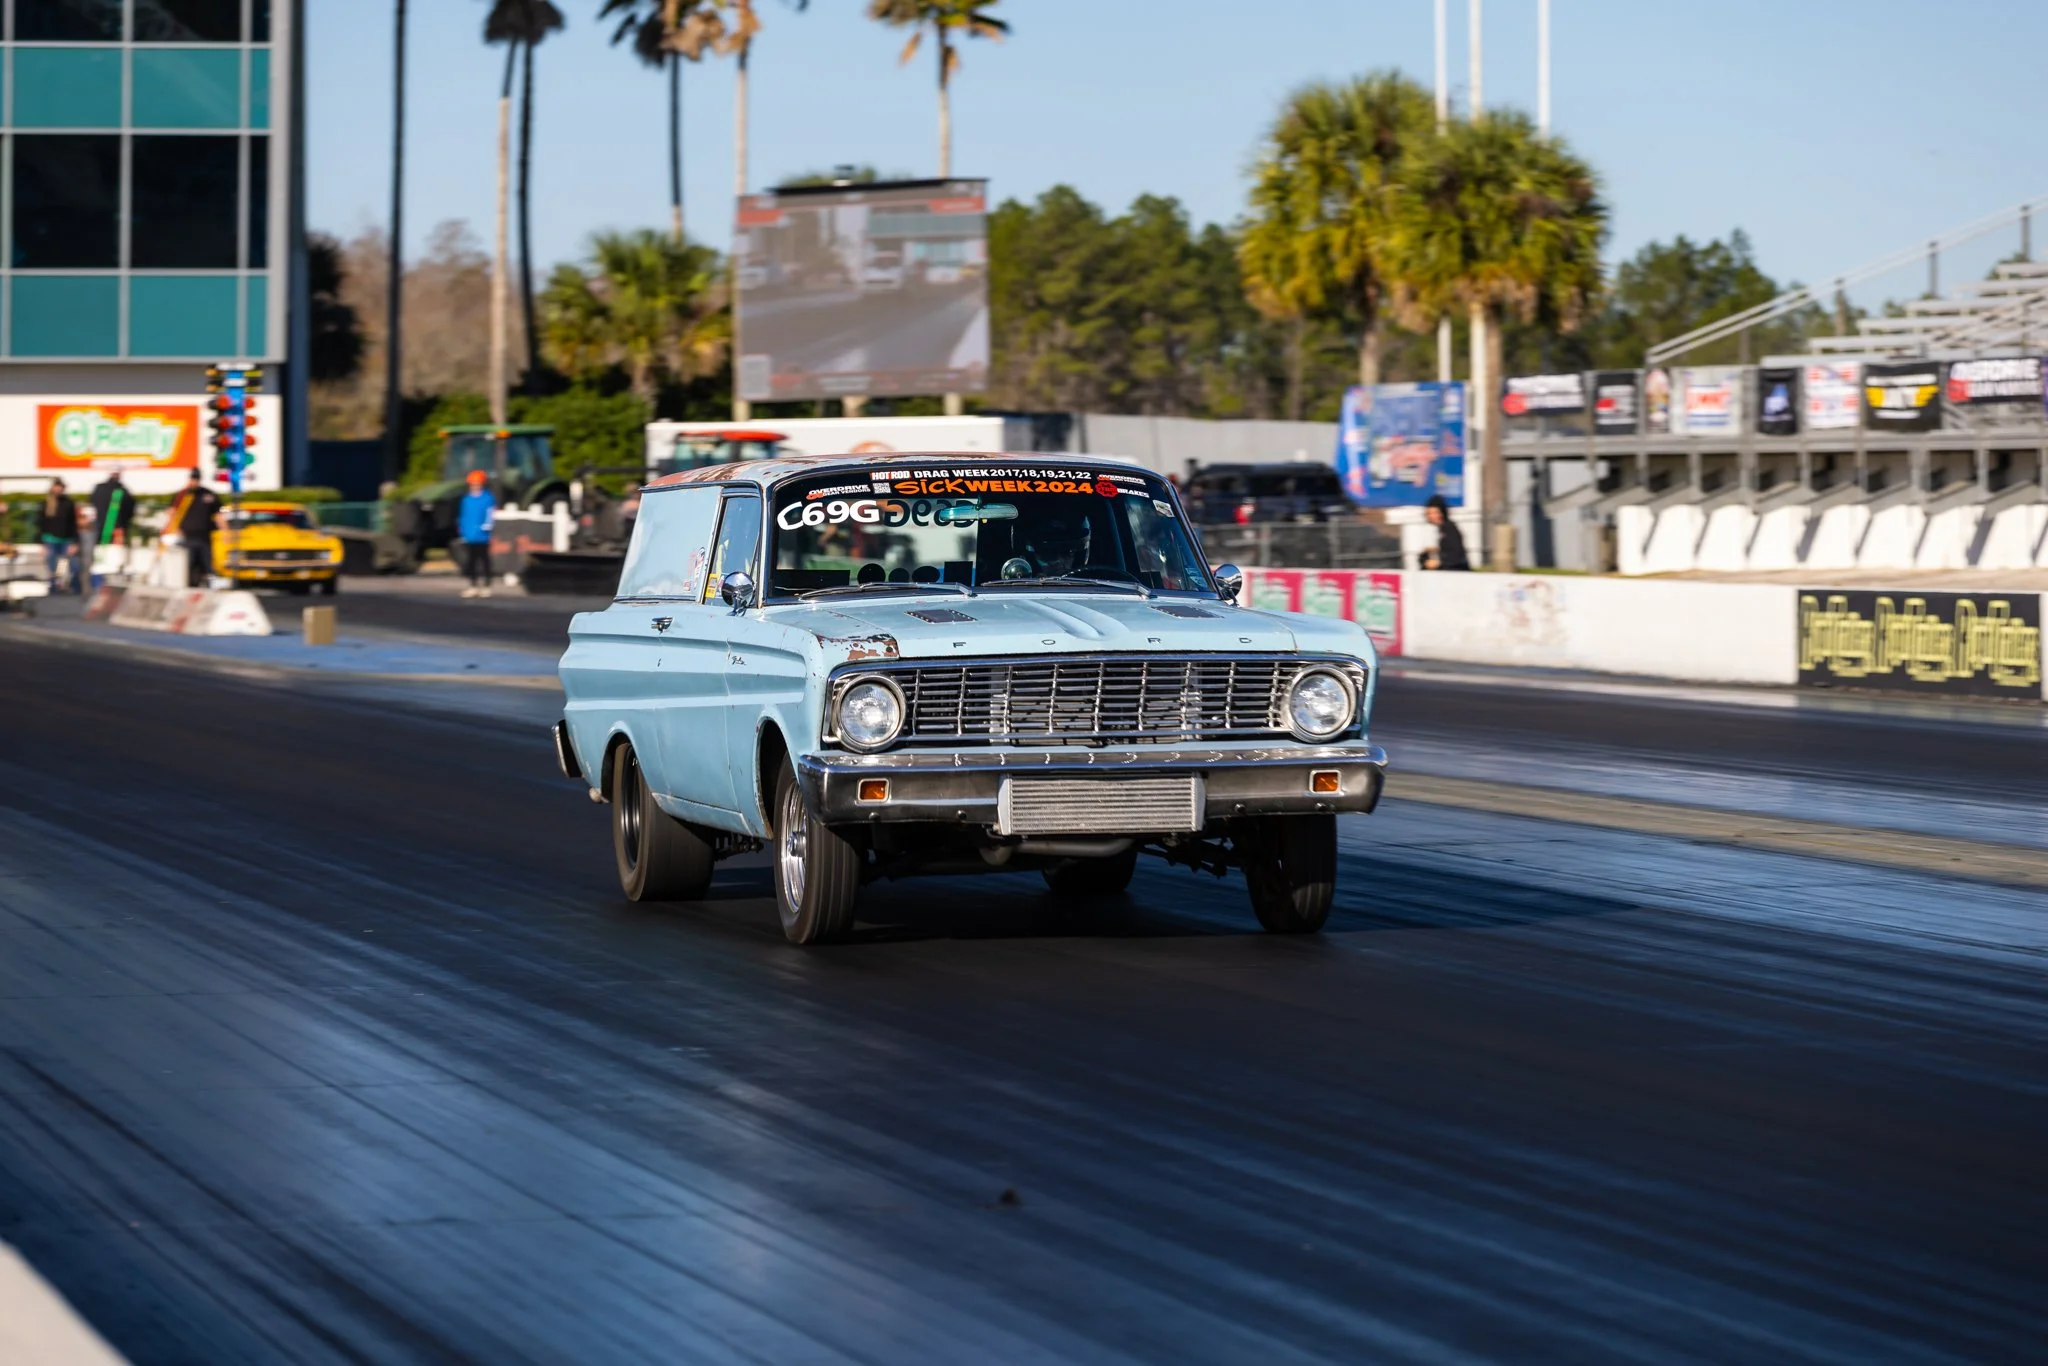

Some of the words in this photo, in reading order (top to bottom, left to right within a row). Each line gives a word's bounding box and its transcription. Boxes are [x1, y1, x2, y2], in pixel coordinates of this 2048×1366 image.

[871, 472, 890, 480] HOT
[891, 471, 910, 479] ROD
[914, 470, 949, 478] DRAG
[808, 484, 869, 495] OVERDRIVE
[1117, 488, 1150, 498] BRAKES
[777, 500, 880, 530] C69G
